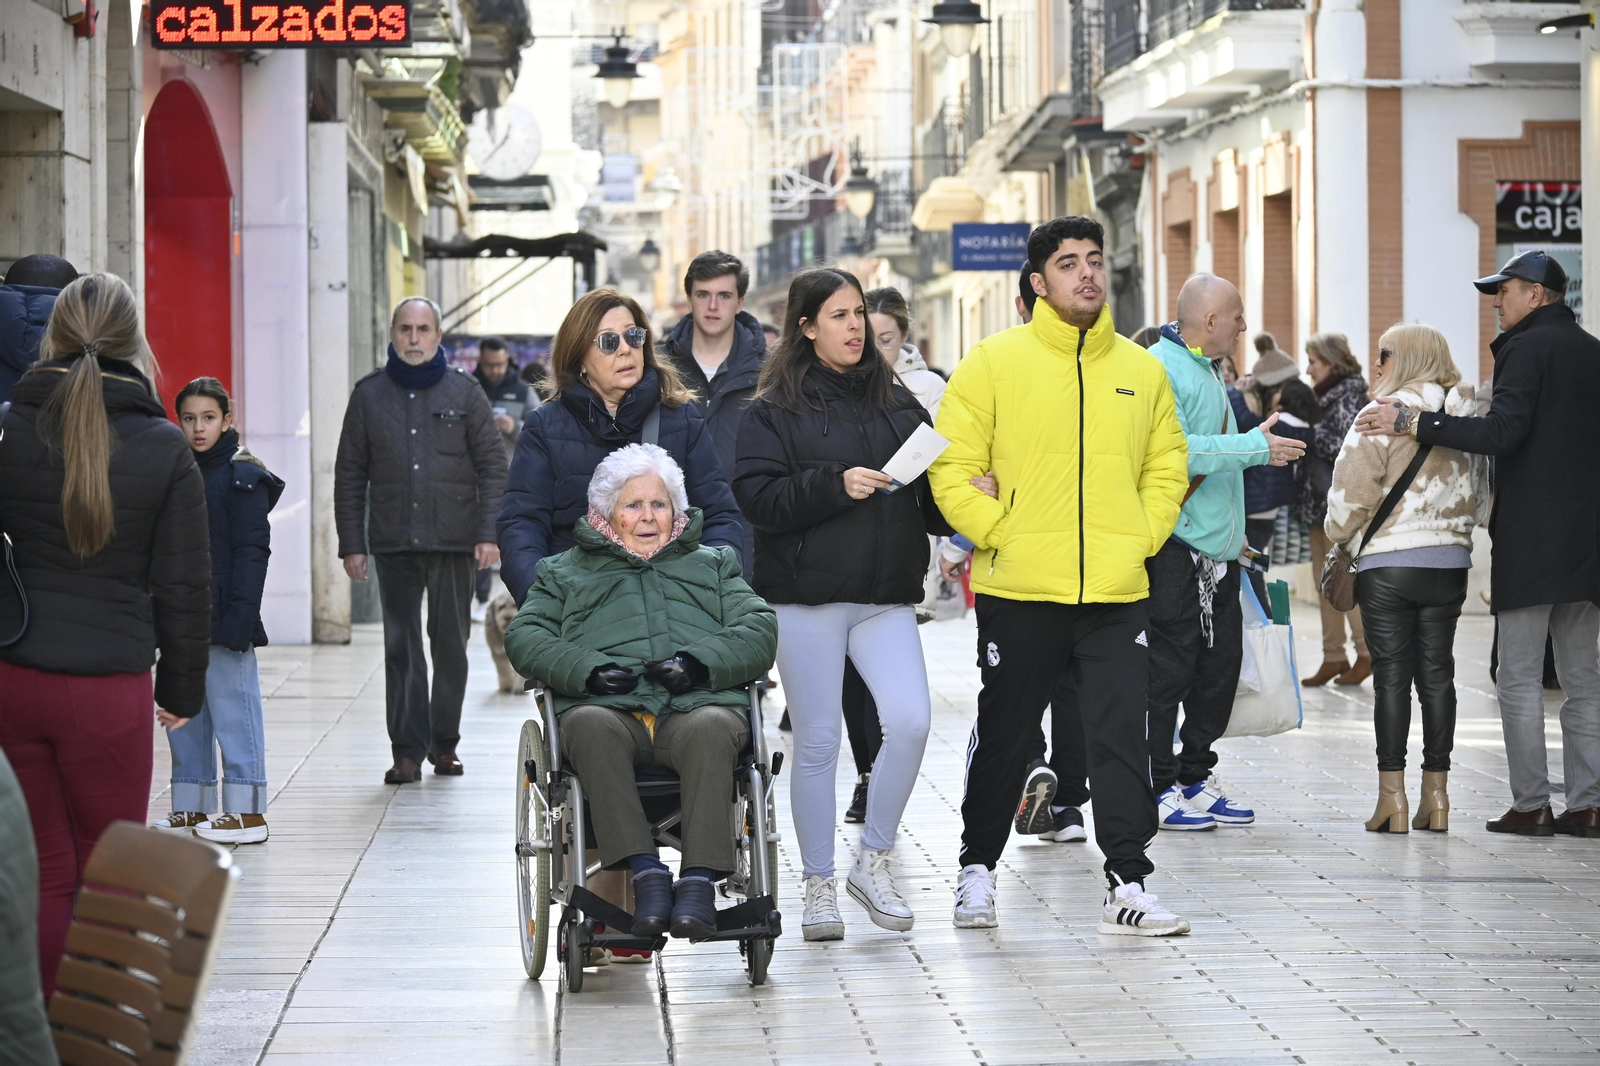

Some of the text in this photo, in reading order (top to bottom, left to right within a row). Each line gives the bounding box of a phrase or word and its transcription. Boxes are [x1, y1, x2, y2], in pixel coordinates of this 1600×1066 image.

[156, 0, 406, 42] calzados
[1515, 198, 1582, 237] caja
[959, 232, 1026, 249] NOTARÍA
